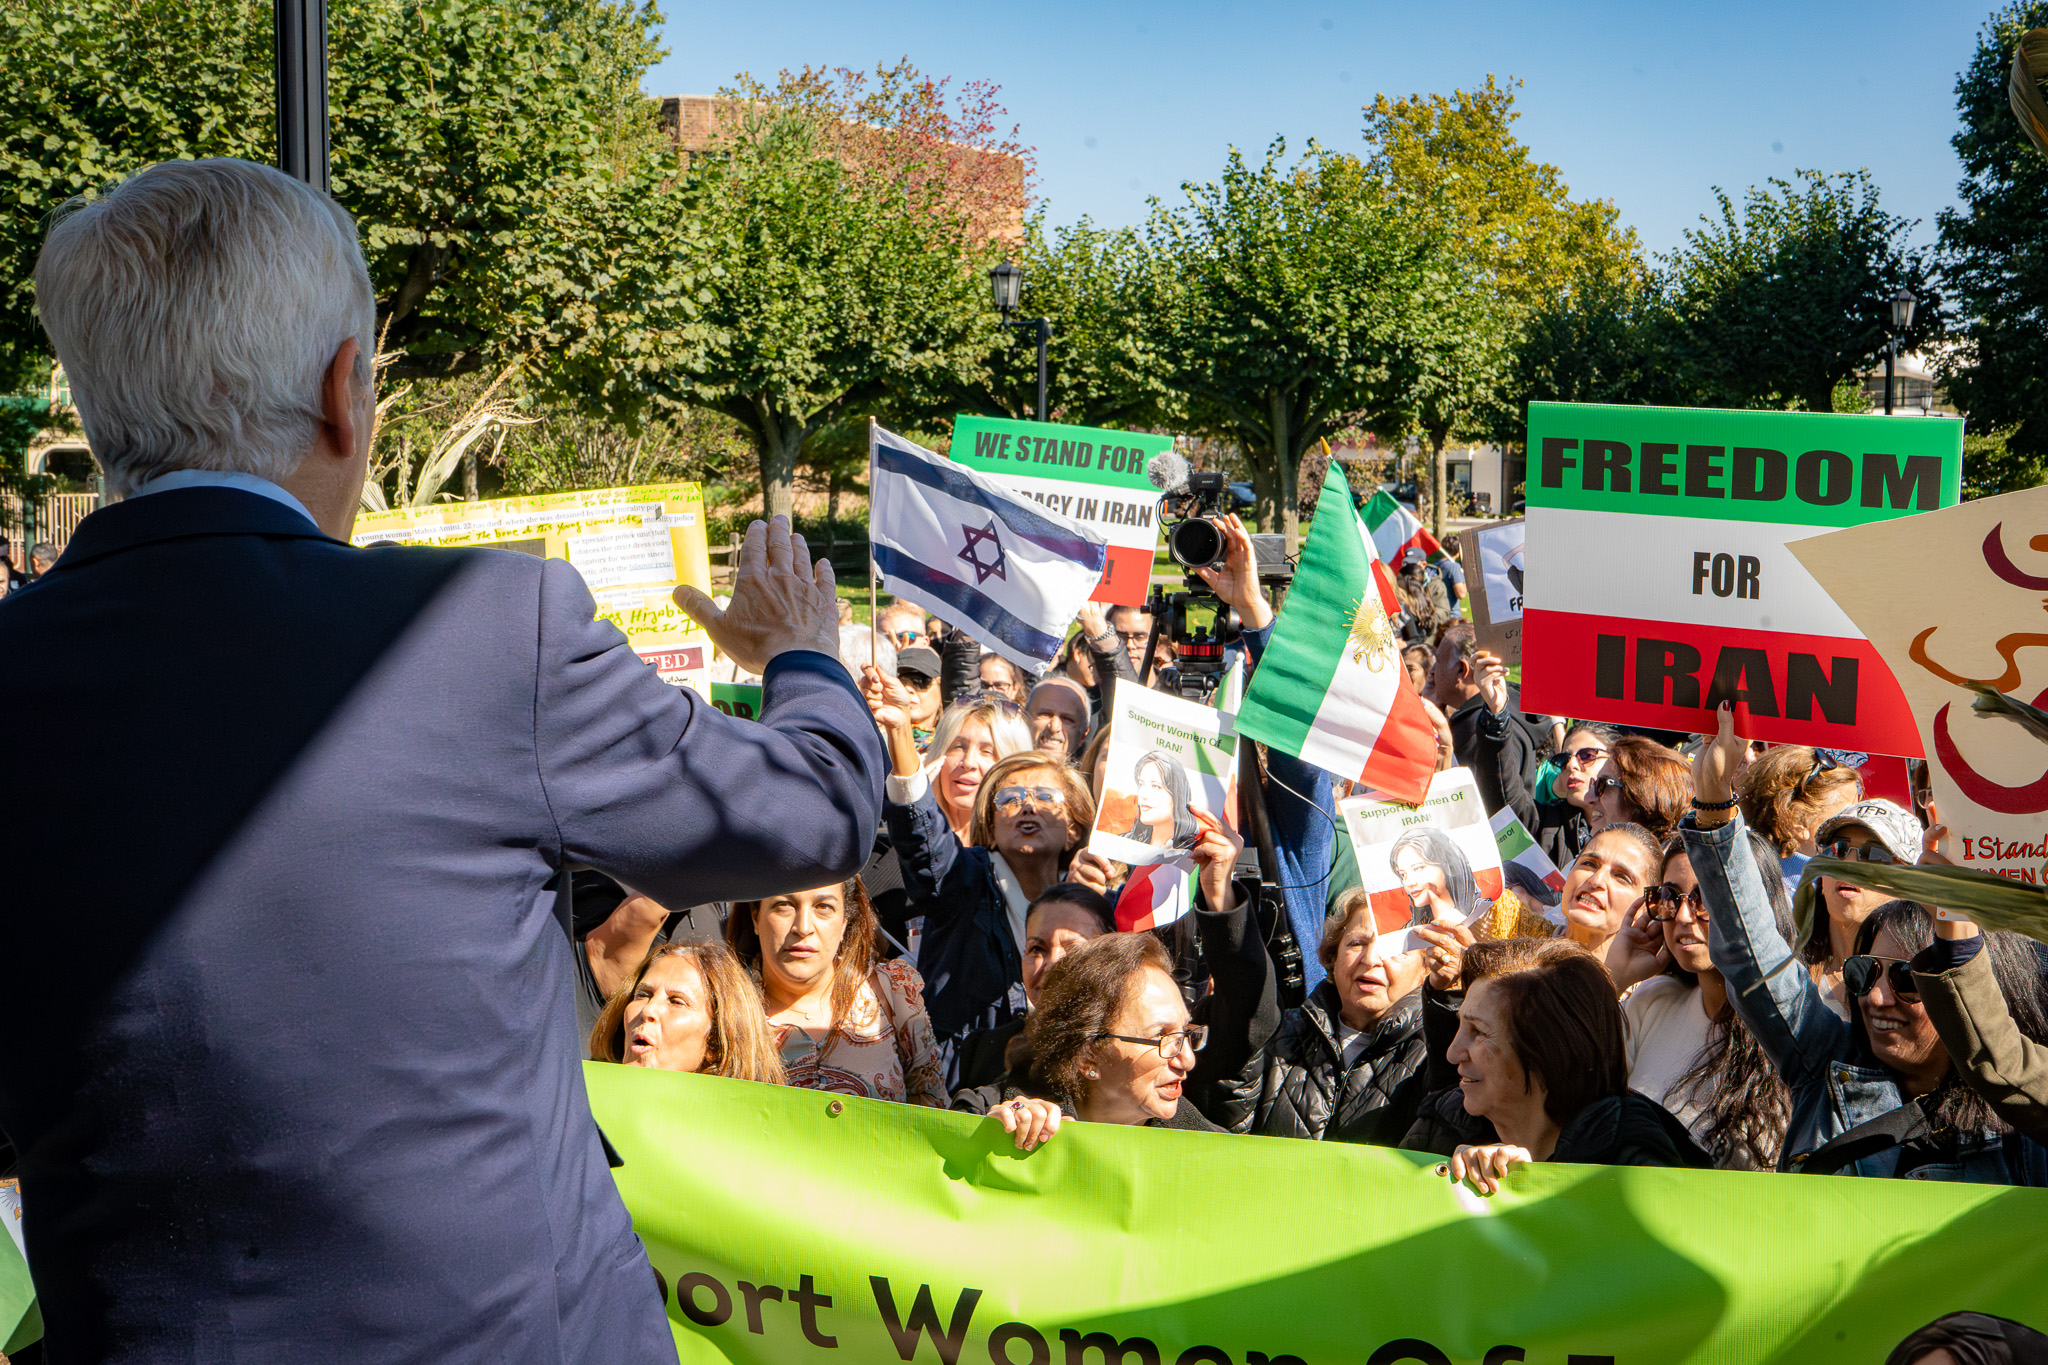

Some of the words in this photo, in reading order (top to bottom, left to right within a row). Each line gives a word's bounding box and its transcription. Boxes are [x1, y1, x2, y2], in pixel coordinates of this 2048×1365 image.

[974, 431, 1011, 460] WE
[1015, 435, 1093, 468] STAND
[1097, 445, 1145, 475] FOR
[1540, 437, 1942, 511] FREEDOM
[361, 534, 384, 543] young
[385, 531, 412, 539] woman
[413, 527, 437, 536] Mahsa
[463, 522, 472, 530] 22
[473, 521, 486, 529] has
[487, 519, 502, 528] died
[505, 517, 524, 527] when
[525, 516, 539, 524] she
[540, 515, 554, 523] was
[555, 511, 585, 521] detained
[586, 510, 595, 519] by
[616, 504, 645, 514] morality
[674, 514, 695, 524] police
[1076, 497, 1099, 521] IN
[1101, 501, 1153, 528] IRAN
[582, 535, 613, 546] specialist
[615, 532, 635, 542] police
[632, 541, 651, 549] dress
[647, 550, 665, 558] since
[599, 566, 615, 574] after
[617, 564, 628, 572] the
[1692, 551, 1760, 600] FOR
[627, 622, 659, 636] crime
[1596, 634, 1859, 726] IRAN
[1128, 710, 1165, 732] Support
[1167, 725, 1206, 745] Women
[1208, 737, 1222, 748] Of
[1156, 737, 1183, 754] IRAN!
[1361, 803, 1404, 819] Support
[1451, 791, 1464, 801] Of
[1402, 813, 1432, 827] IRAN!
[1507, 827, 1515, 836] Of
[1962, 837, 1975, 860] I
[1978, 833, 2048, 861] Stand
[654, 1267, 839, 1349] ort
